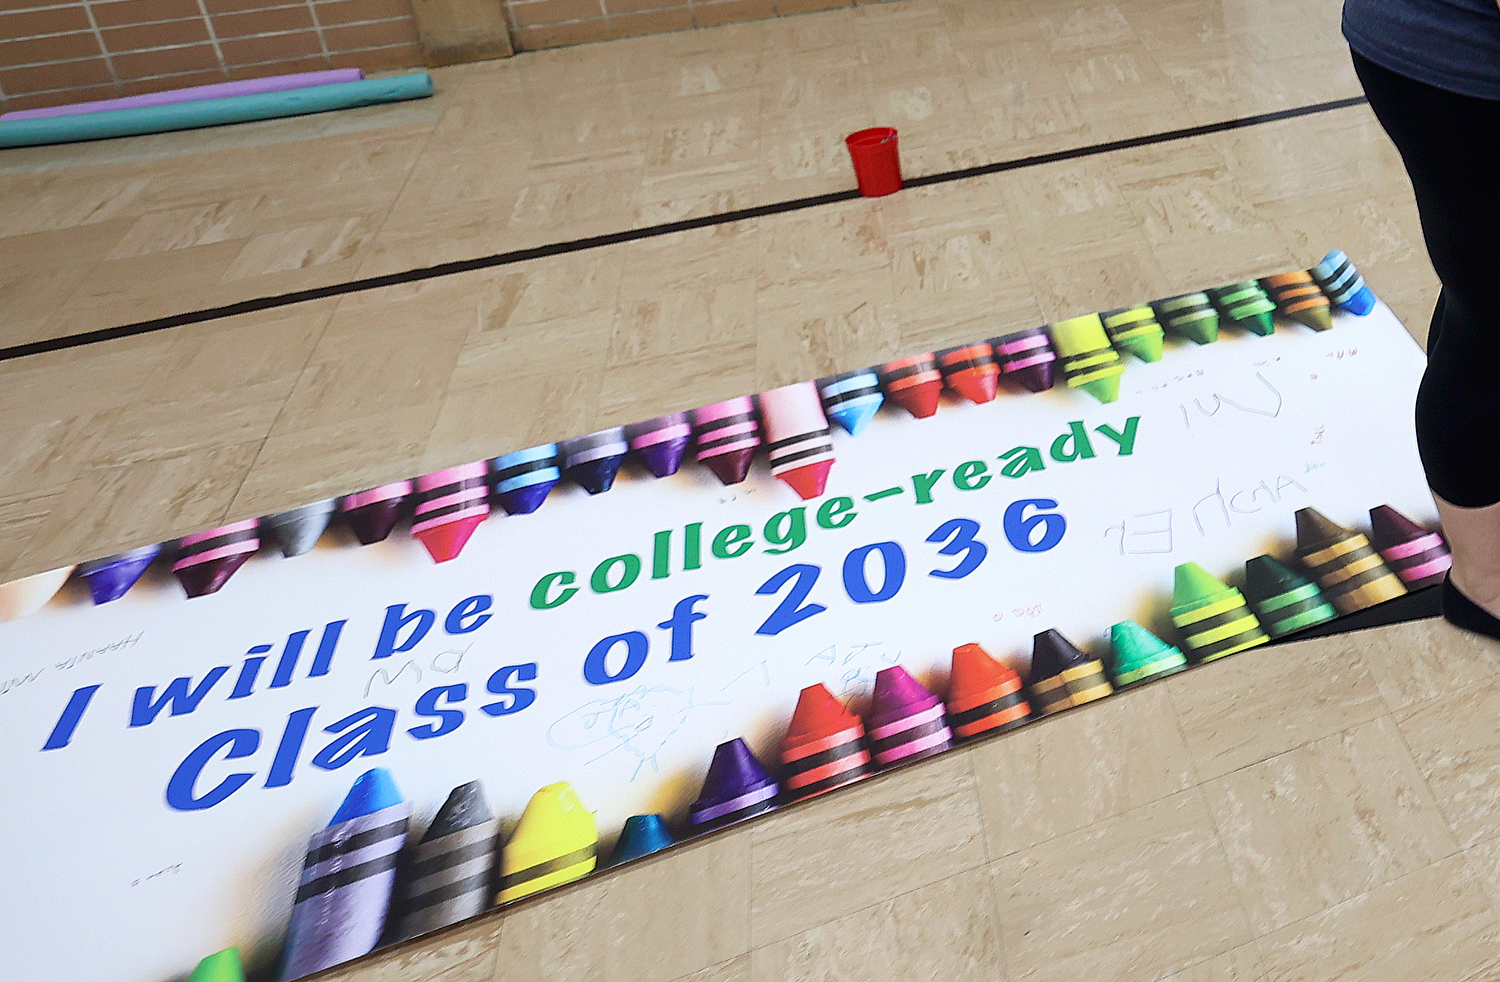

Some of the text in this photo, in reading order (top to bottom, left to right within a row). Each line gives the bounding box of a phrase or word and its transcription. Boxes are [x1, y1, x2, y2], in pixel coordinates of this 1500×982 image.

[41, 683, 102, 751] I
[128, 618, 349, 728] will
[373, 594, 494, 660] be
[530, 415, 1141, 610] college-ready
[163, 497, 1067, 811] Class of 2036
